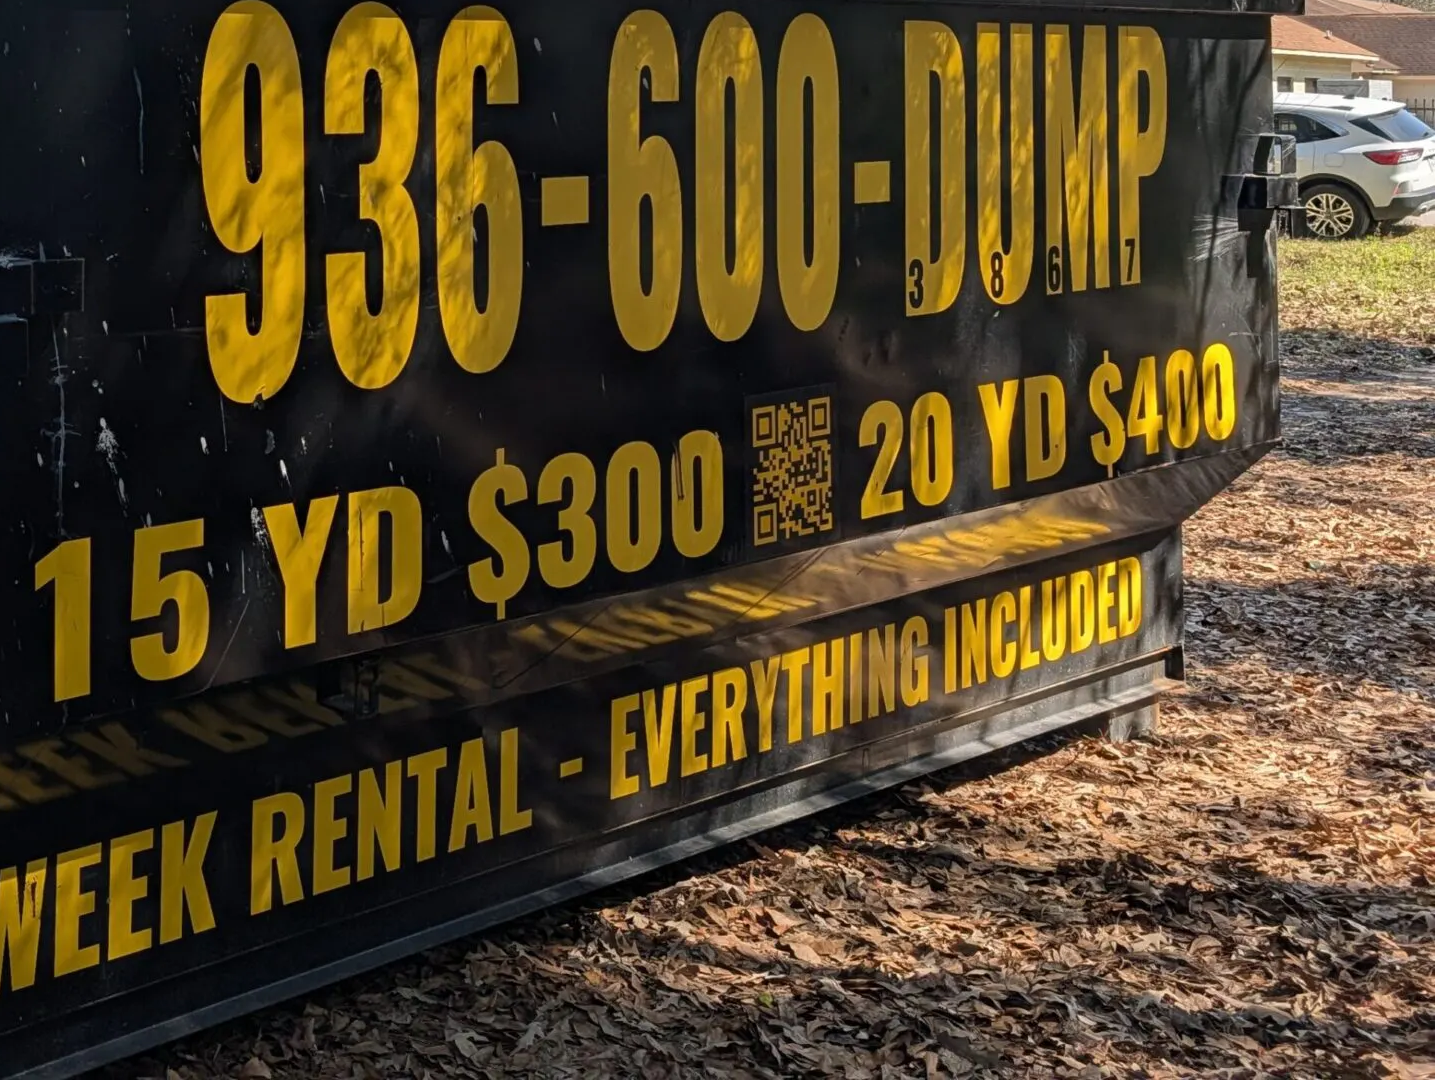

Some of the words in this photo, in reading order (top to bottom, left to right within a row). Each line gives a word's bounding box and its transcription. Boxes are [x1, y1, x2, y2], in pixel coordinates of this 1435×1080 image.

[199, 0, 1168, 405] 936-600-DUMP
[34, 518, 210, 703] 15
[261, 485, 423, 650] YD
[467, 430, 724, 620] $300
[858, 391, 955, 520] 20
[976, 374, 1067, 491] YD
[1088, 342, 1237, 478] $400
[250, 726, 533, 916] RENTAL
[609, 615, 930, 801] EVERYTHING
[943, 555, 1144, 695] INCLUDED
